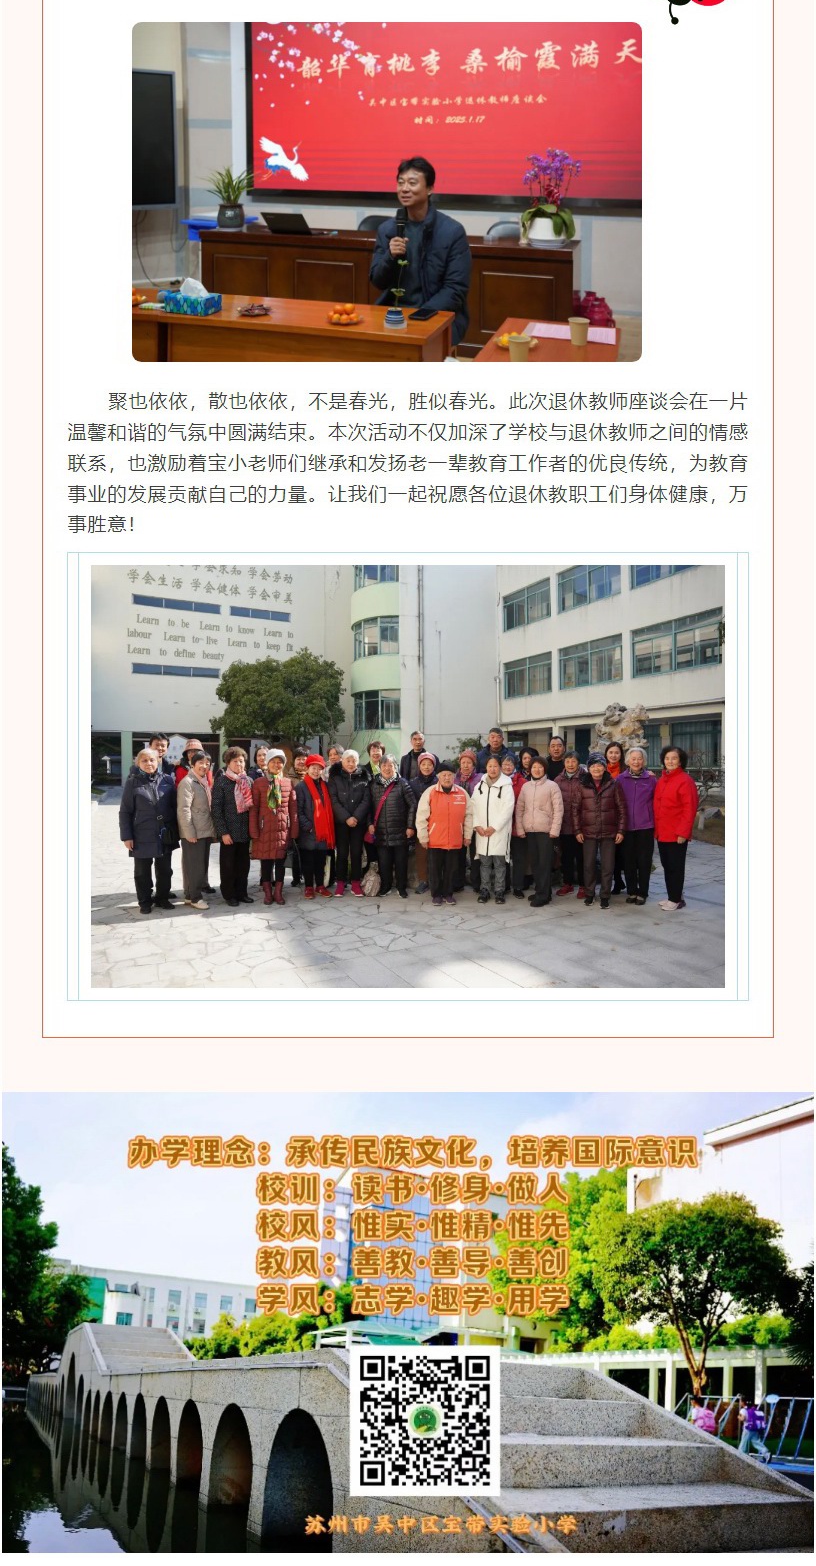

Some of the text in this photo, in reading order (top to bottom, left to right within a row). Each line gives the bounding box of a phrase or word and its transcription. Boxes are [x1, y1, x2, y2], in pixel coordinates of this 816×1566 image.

[296, 38, 642, 79] 韶华育桃李 桑榆霞满天
[108, 390, 748, 412] 聚也依依，散也依依，不是春光，胜似春光。此次退休教师座谈会在一片
[67, 421, 749, 443] 温馨和谐的气氛中圆满结束。本次活动不仅加深了学校与退休教师之间的情感
[67, 452, 748, 474] 联系，也激励着宝小老师们继承和发扬老一辈教育工作者的优良传统，为教育
[67, 483, 748, 505] 事业的发展贡献自己的力量。让我们一起祝愿各位退休教职工们身体健康，万
[67, 514, 135, 534] 事胜意！
[127, 569, 183, 590] 学会生活
[136, 614, 294, 639] Learn to be Learn to know Learn to
[127, 628, 152, 639] labour
[164, 632, 185, 642] Learn
[192, 636, 200, 644] to
[206, 636, 218, 645] live
[227, 638, 247, 648] Learn
[254, 641, 261, 649] to
[266, 641, 281, 652] keep
[127, 644, 224, 660] Learn to define beauty
